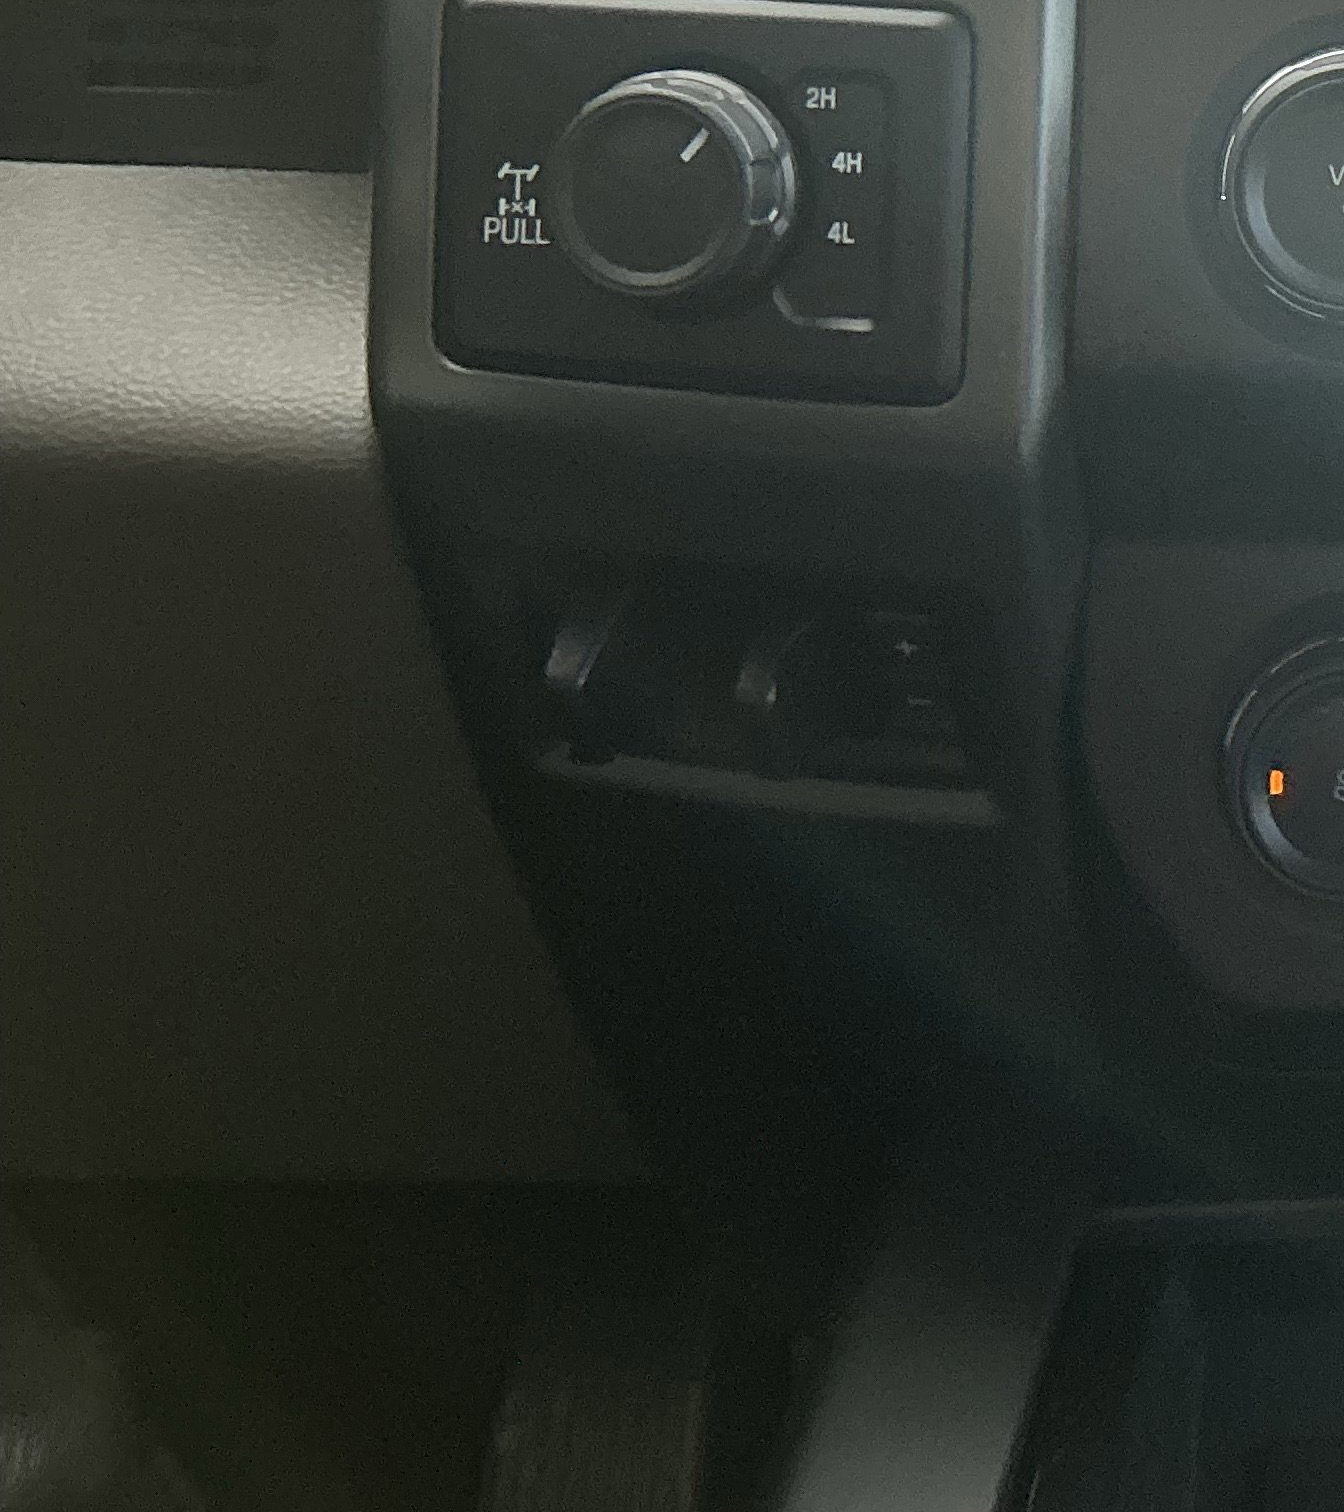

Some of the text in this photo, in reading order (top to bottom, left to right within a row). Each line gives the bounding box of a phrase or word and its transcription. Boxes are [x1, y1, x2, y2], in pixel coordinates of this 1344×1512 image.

[806, 88, 836, 109] 2H
[831, 152, 862, 173] 4H
[483, 217, 550, 245] PULL
[827, 222, 855, 244] 4L
